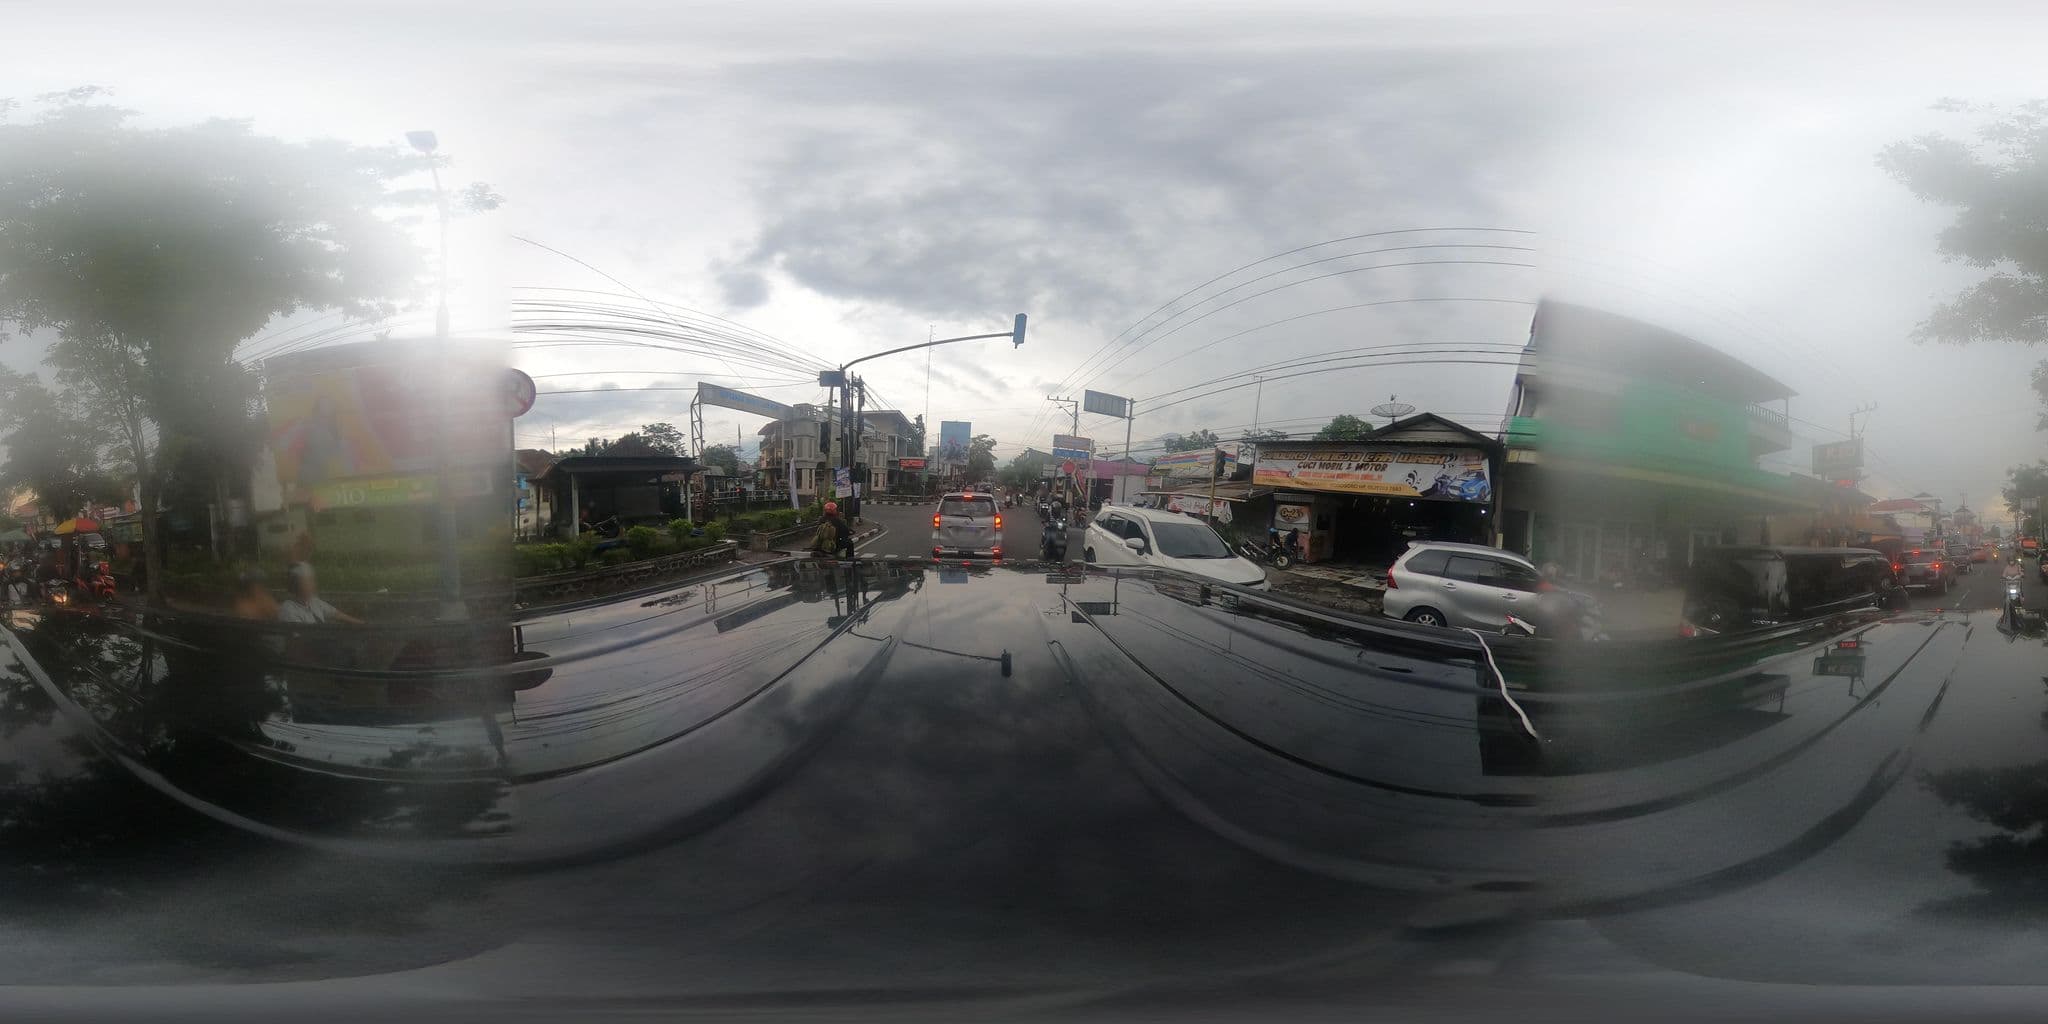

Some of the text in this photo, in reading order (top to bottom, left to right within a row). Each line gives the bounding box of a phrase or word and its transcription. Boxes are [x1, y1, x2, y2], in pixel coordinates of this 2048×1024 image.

[1363, 451, 1395, 463] CAR
[1395, 452, 1446, 464] WASH
[1297, 461, 1316, 470] CUCI
[1318, 462, 1344, 471] MOBIL
[1355, 462, 1388, 472] MOTOR
